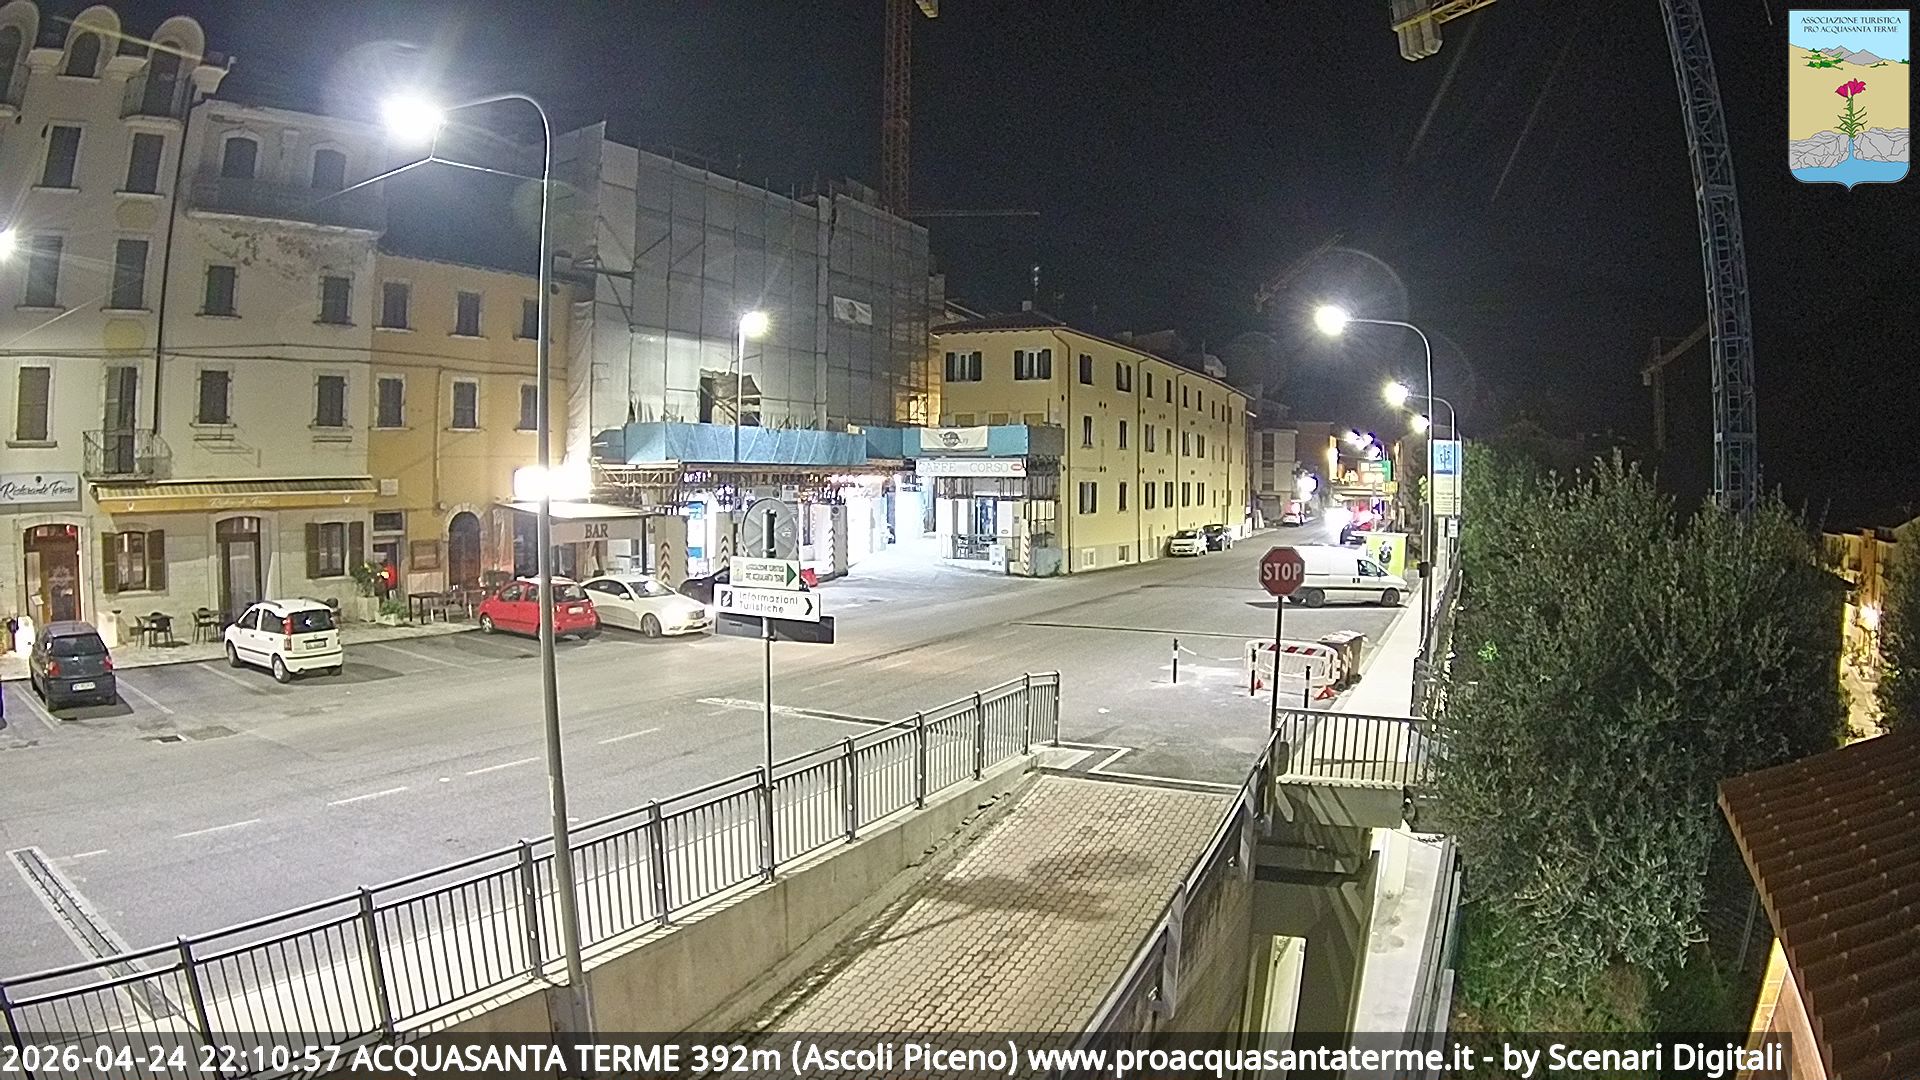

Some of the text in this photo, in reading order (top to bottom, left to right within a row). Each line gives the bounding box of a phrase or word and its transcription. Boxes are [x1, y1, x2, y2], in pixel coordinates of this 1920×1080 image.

[969, 462, 1009, 474] CORSO
[584, 523, 609, 539] BAR
[1263, 562, 1302, 581] STOP
[739, 591, 799, 605] Informazioni
[739, 600, 785, 614] Turistiche
